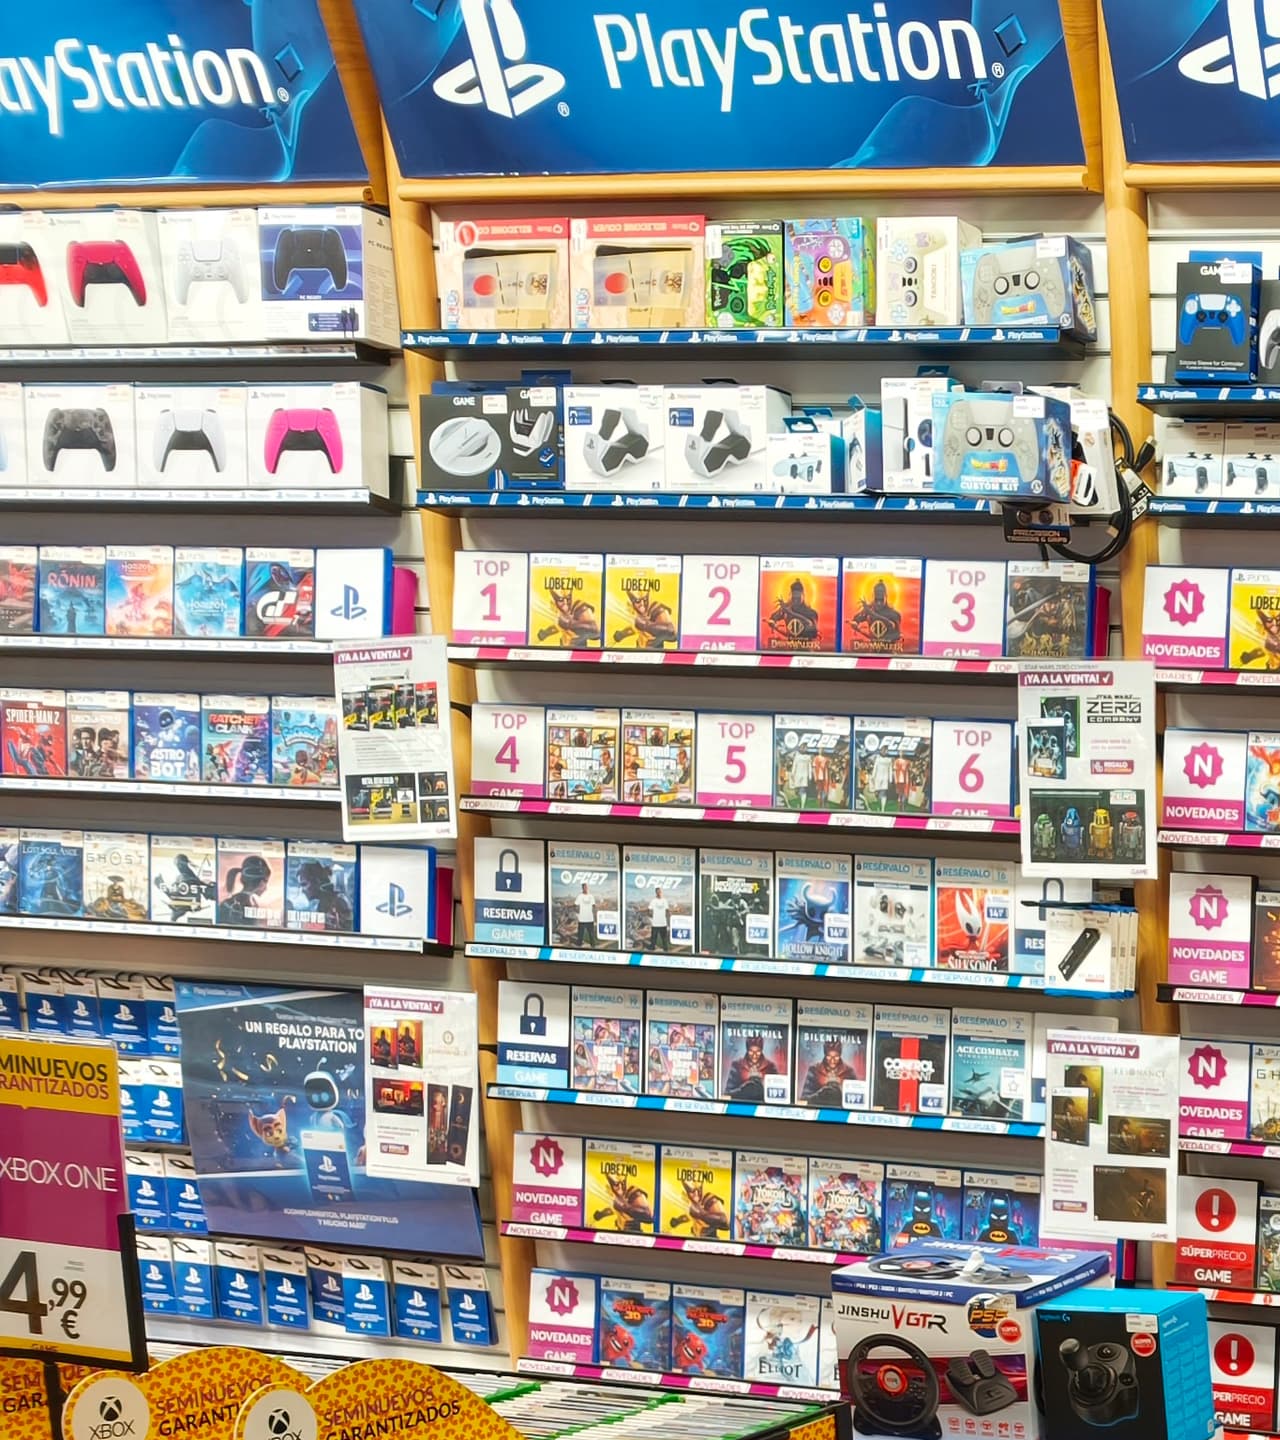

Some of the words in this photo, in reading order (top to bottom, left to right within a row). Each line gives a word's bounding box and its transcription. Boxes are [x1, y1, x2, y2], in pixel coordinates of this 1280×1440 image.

[593, 2, 987, 112] PlayStation
[0, 34, 277, 135] ayStation
[453, 396, 475, 406] GAME
[474, 559, 510, 576] TOP
[704, 562, 740, 580] TOP
[621, 577, 661, 592] LOBEZNO
[948, 569, 986, 586] TOP
[481, 583, 501, 621] 1
[707, 588, 731, 625] 2
[951, 592, 975, 632] 3
[1146, 642, 1221, 658] NOVEDADES
[492, 713, 527, 730] TOP
[717, 721, 756, 739] TOP
[953, 729, 992, 748] TOP
[495, 736, 519, 773] 4
[151, 760, 186, 777] BOT
[725, 746, 747, 783] 5
[959, 753, 984, 793] 6
[1166, 806, 1239, 822] NOVEDADES
[483, 906, 533, 920] RESERVAS
[1173, 946, 1244, 962] NOVEDADES
[1190, 970, 1227, 983] GAME
[245, 1022, 264, 1032] UN
[265, 1023, 311, 1038] REGALO
[315, 1027, 344, 1038] PARA
[348, 1029, 364, 1040] TO
[279, 1038, 357, 1053] PLAYSTATION
[506, 1049, 556, 1064] RESERVAS
[0, 1055, 108, 1083] MINUEVOS
[0, 1074, 109, 1101] RANTIZADOS
[0, 1157, 62, 1186] XBOX
[65, 1165, 117, 1192] ONE
[838, 1303, 890, 1319] JINSHU
[61, 1310, 80, 1339] €
[323, 1387, 435, 1429] SEMINUEVOS
